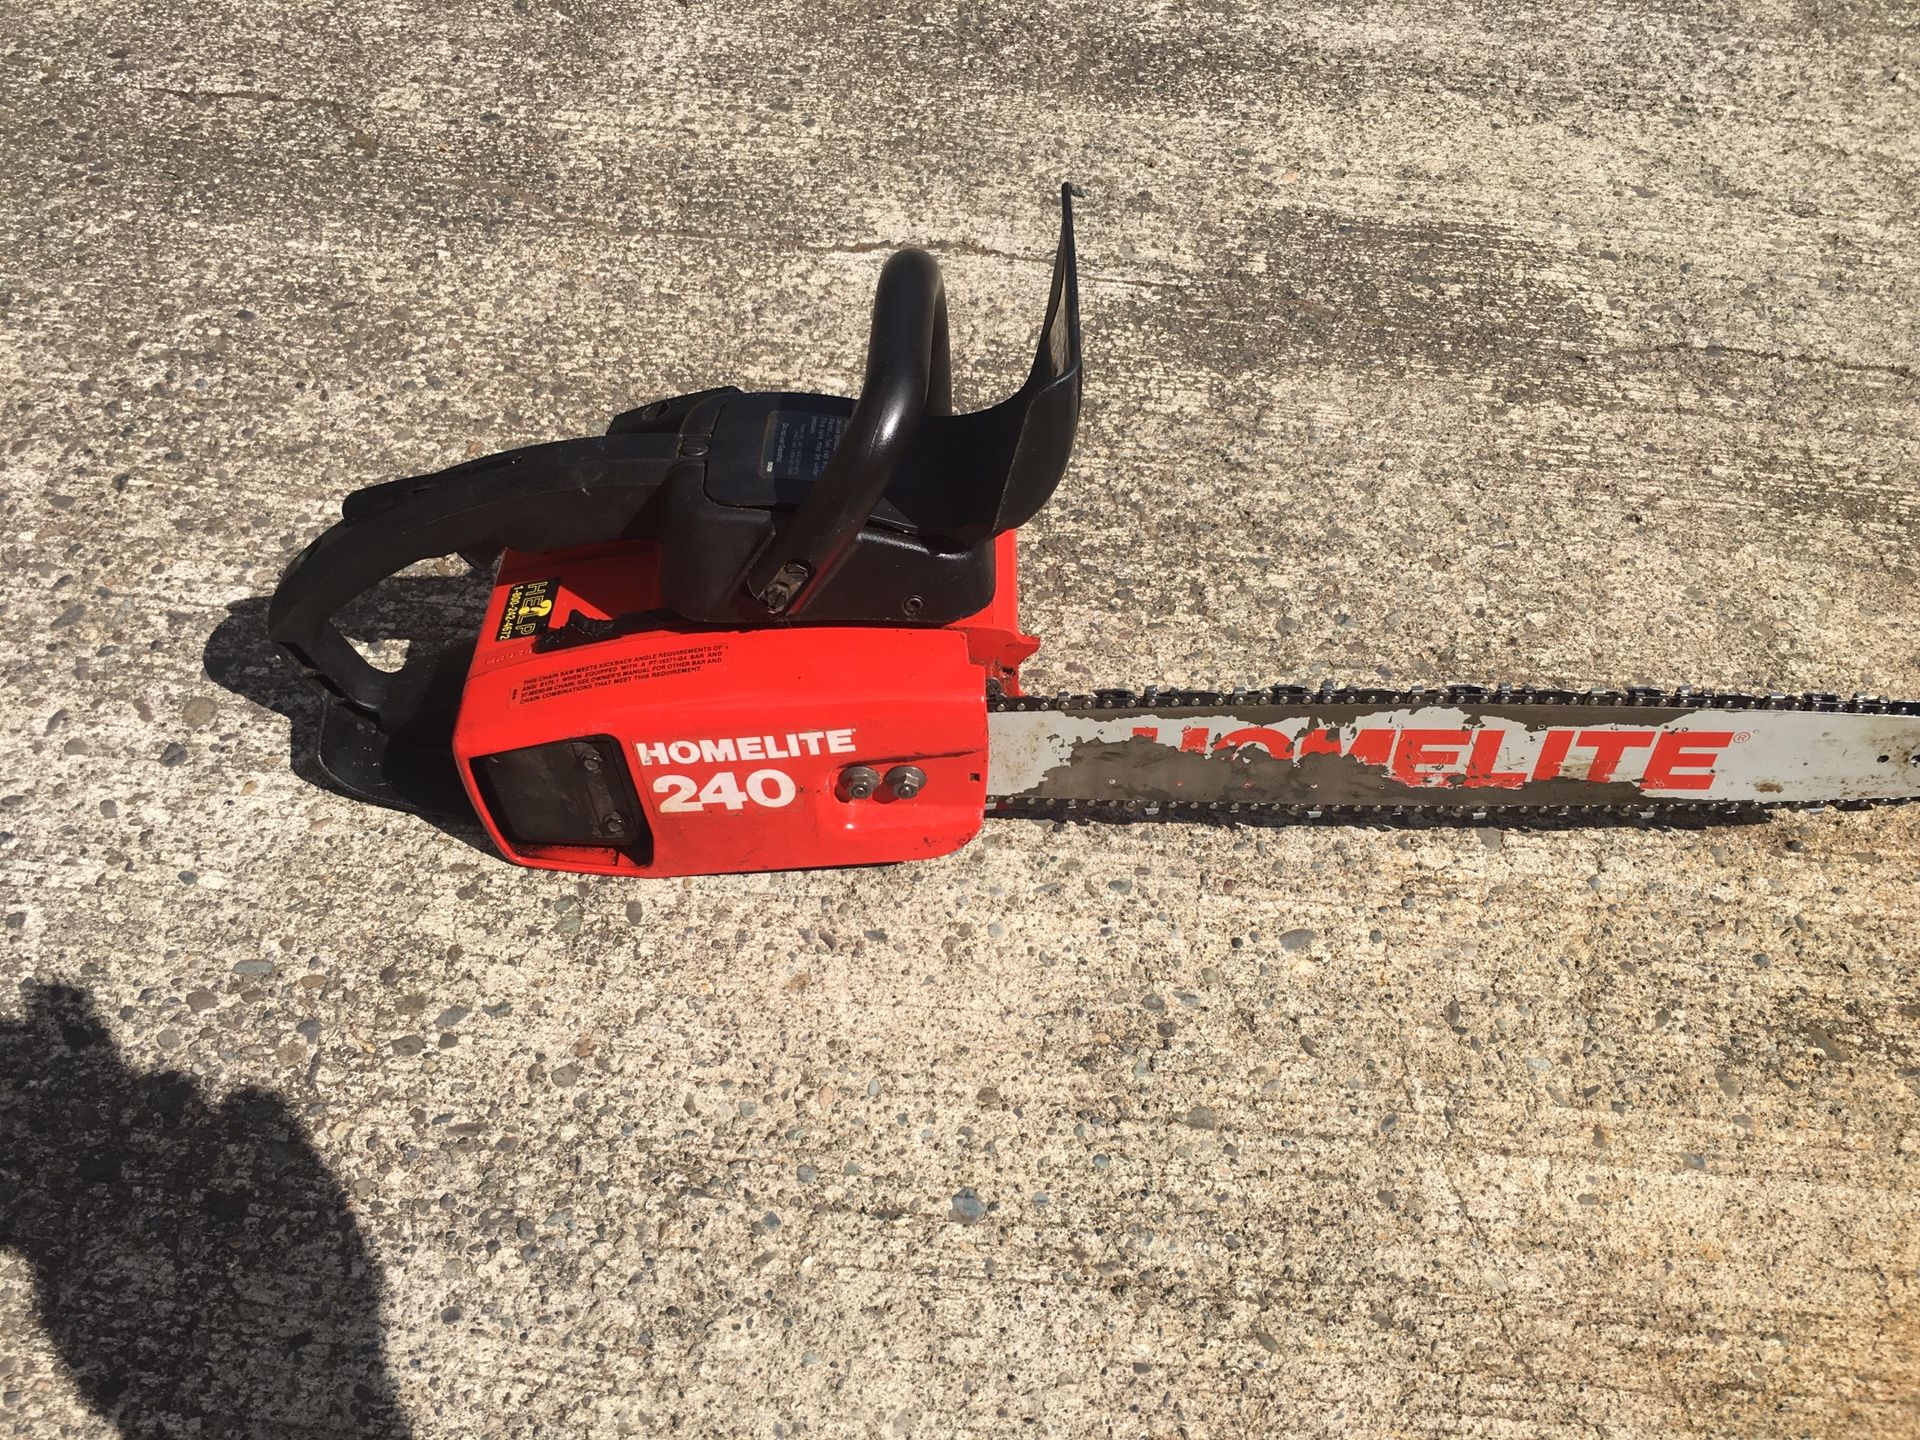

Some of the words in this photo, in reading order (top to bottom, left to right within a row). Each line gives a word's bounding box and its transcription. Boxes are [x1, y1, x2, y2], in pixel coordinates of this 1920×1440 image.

[538, 673, 559, 682] CHAIN
[576, 664, 598, 673] MEETS
[598, 659, 632, 670] KICKBACK
[658, 646, 712, 658] REQUIREMENTS
[584, 668, 618, 678] EQUIPPED
[590, 673, 621, 682] OWNER'S
[622, 669, 650, 677] MANUAL
[520, 696, 540, 704] CHAIN
[542, 685, 592, 699] COMBINATIONS
[635, 729, 856, 766] HOMELITE
[1130, 727, 1734, 792] MELITE
[652, 768, 796, 813] 240
